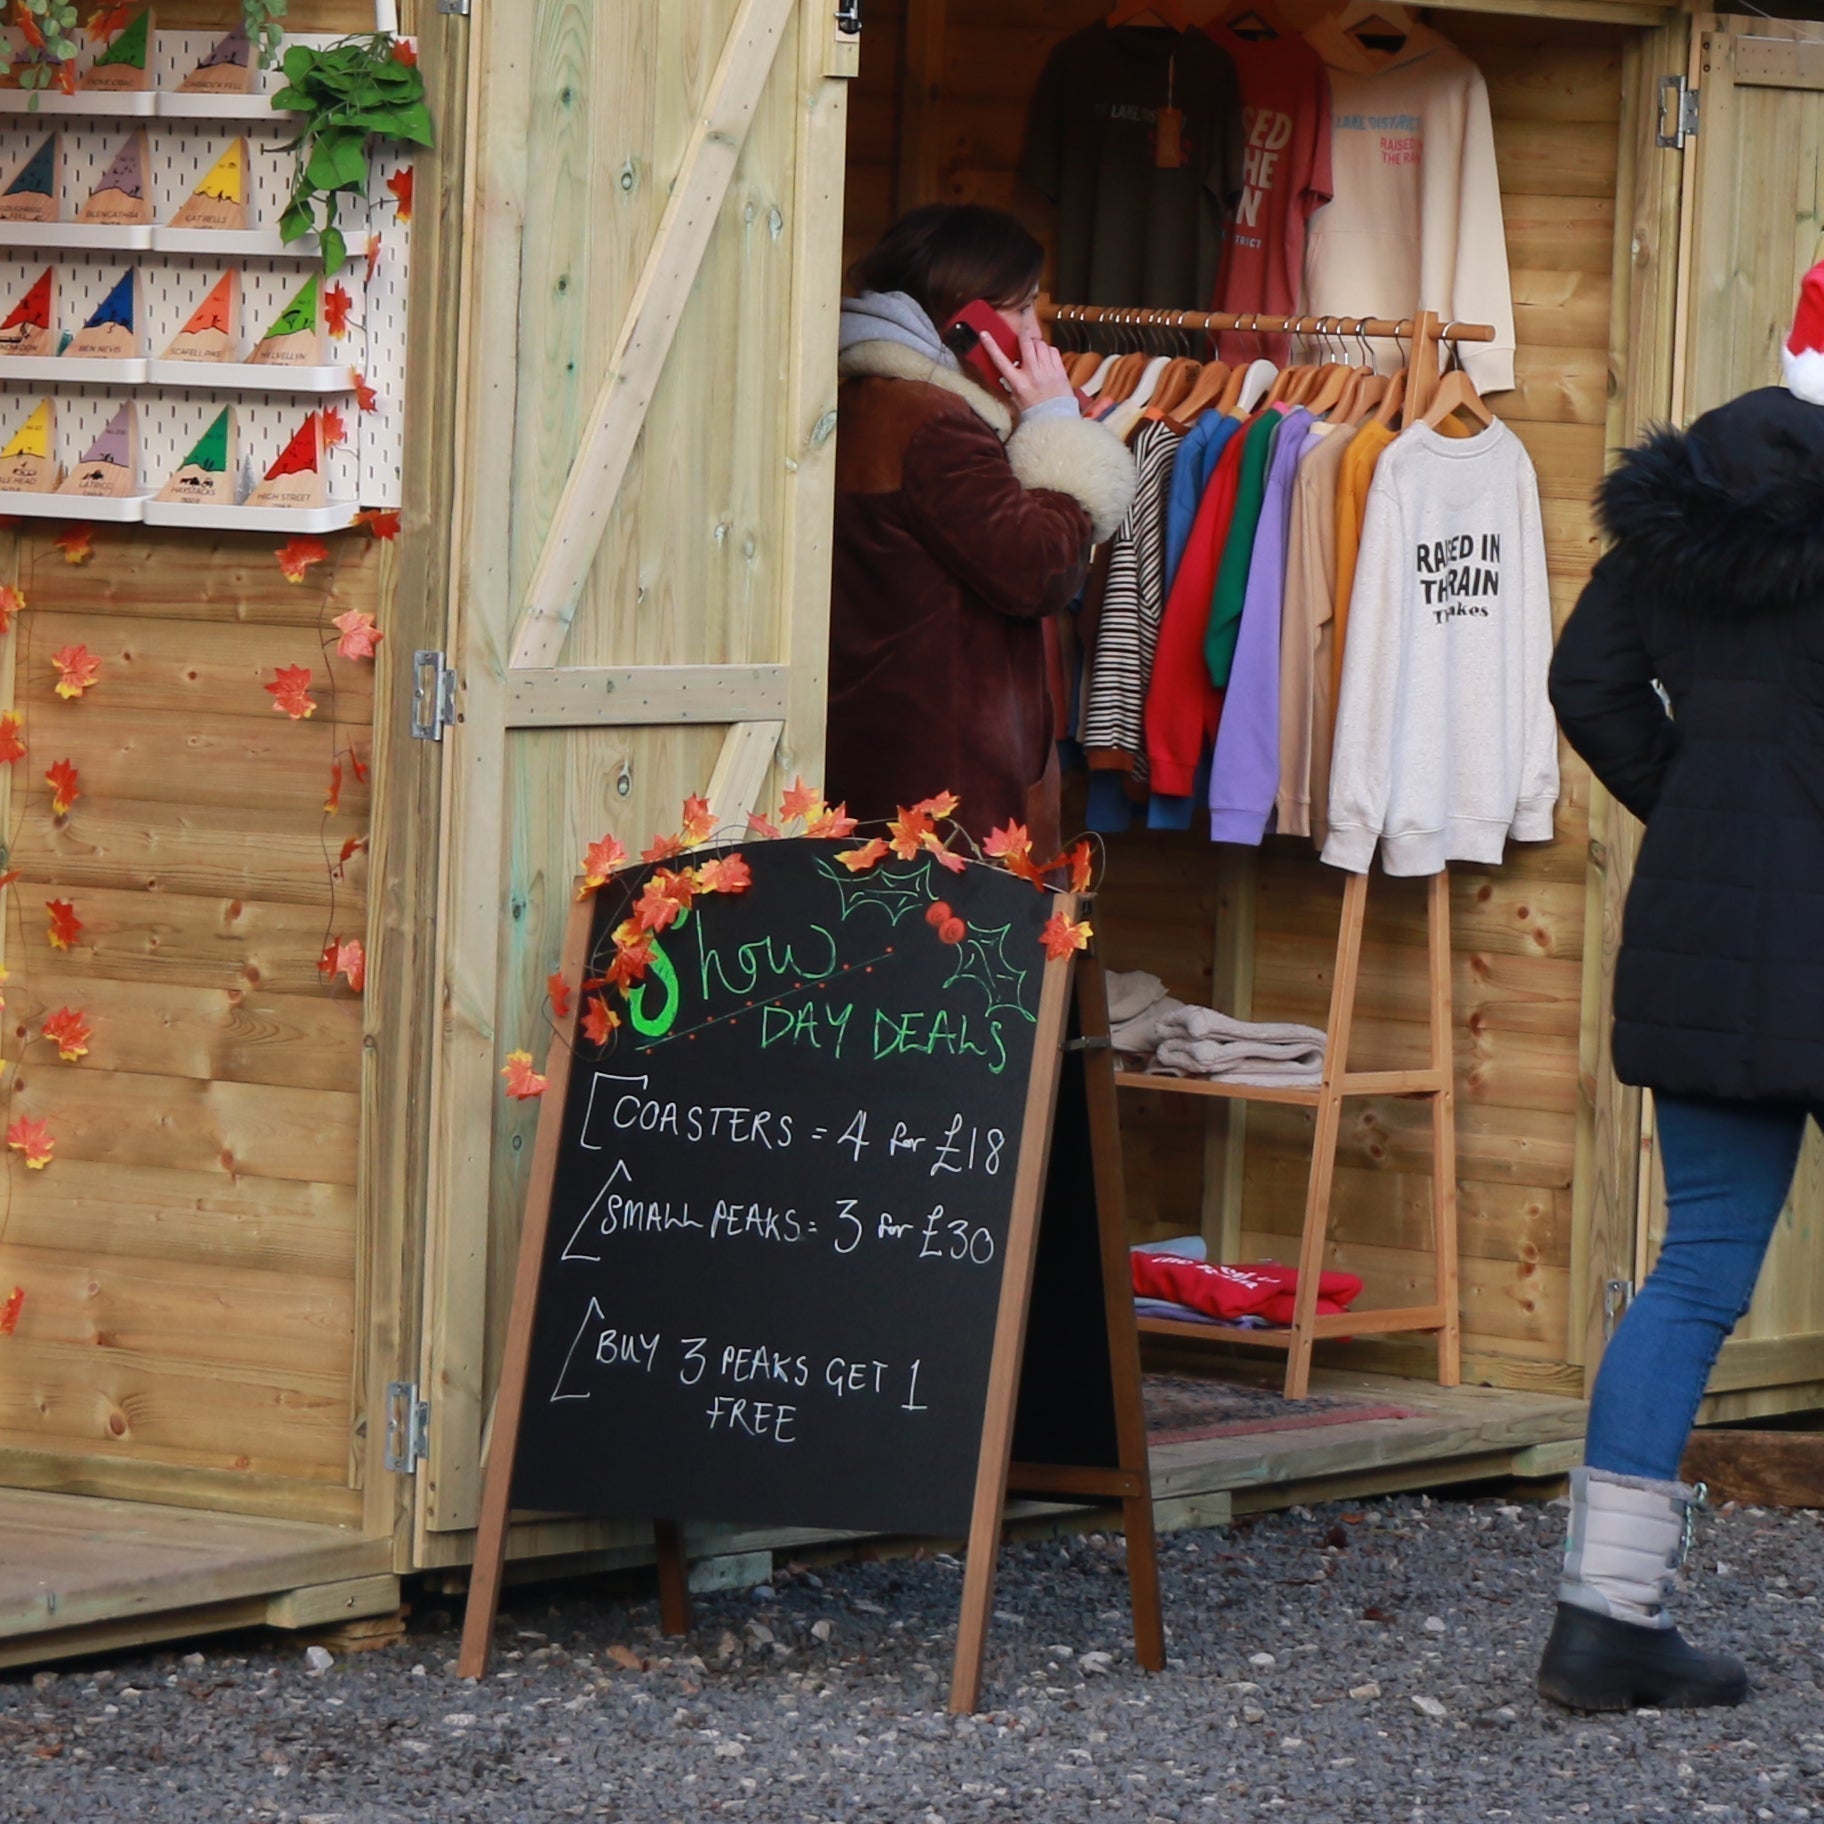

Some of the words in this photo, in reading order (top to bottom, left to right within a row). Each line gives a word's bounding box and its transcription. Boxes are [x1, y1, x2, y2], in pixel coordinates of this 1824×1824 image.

[1448, 565, 1498, 597] RAIN
[1481, 533, 1500, 563] IN
[759, 1000, 855, 1061] DAY
[873, 1008, 1009, 1076] DEALS
[611, 1093, 794, 1151] COASTERS
[836, 1108, 871, 1163] 4
[889, 1121, 928, 1157] for
[929, 1112, 1007, 1177] £18
[600, 1193, 705, 1237] SMALL
[833, 1198, 864, 1255] 3
[877, 1211, 915, 1240] for
[918, 1203, 996, 1265] £30
[595, 1328, 661, 1373] BUY
[679, 1336, 709, 1386] 3
[720, 1344, 809, 1388] PEAKS
[824, 1356, 890, 1398] GET
[900, 1358, 928, 1411] 1
[705, 1395, 797, 1444] FREE
